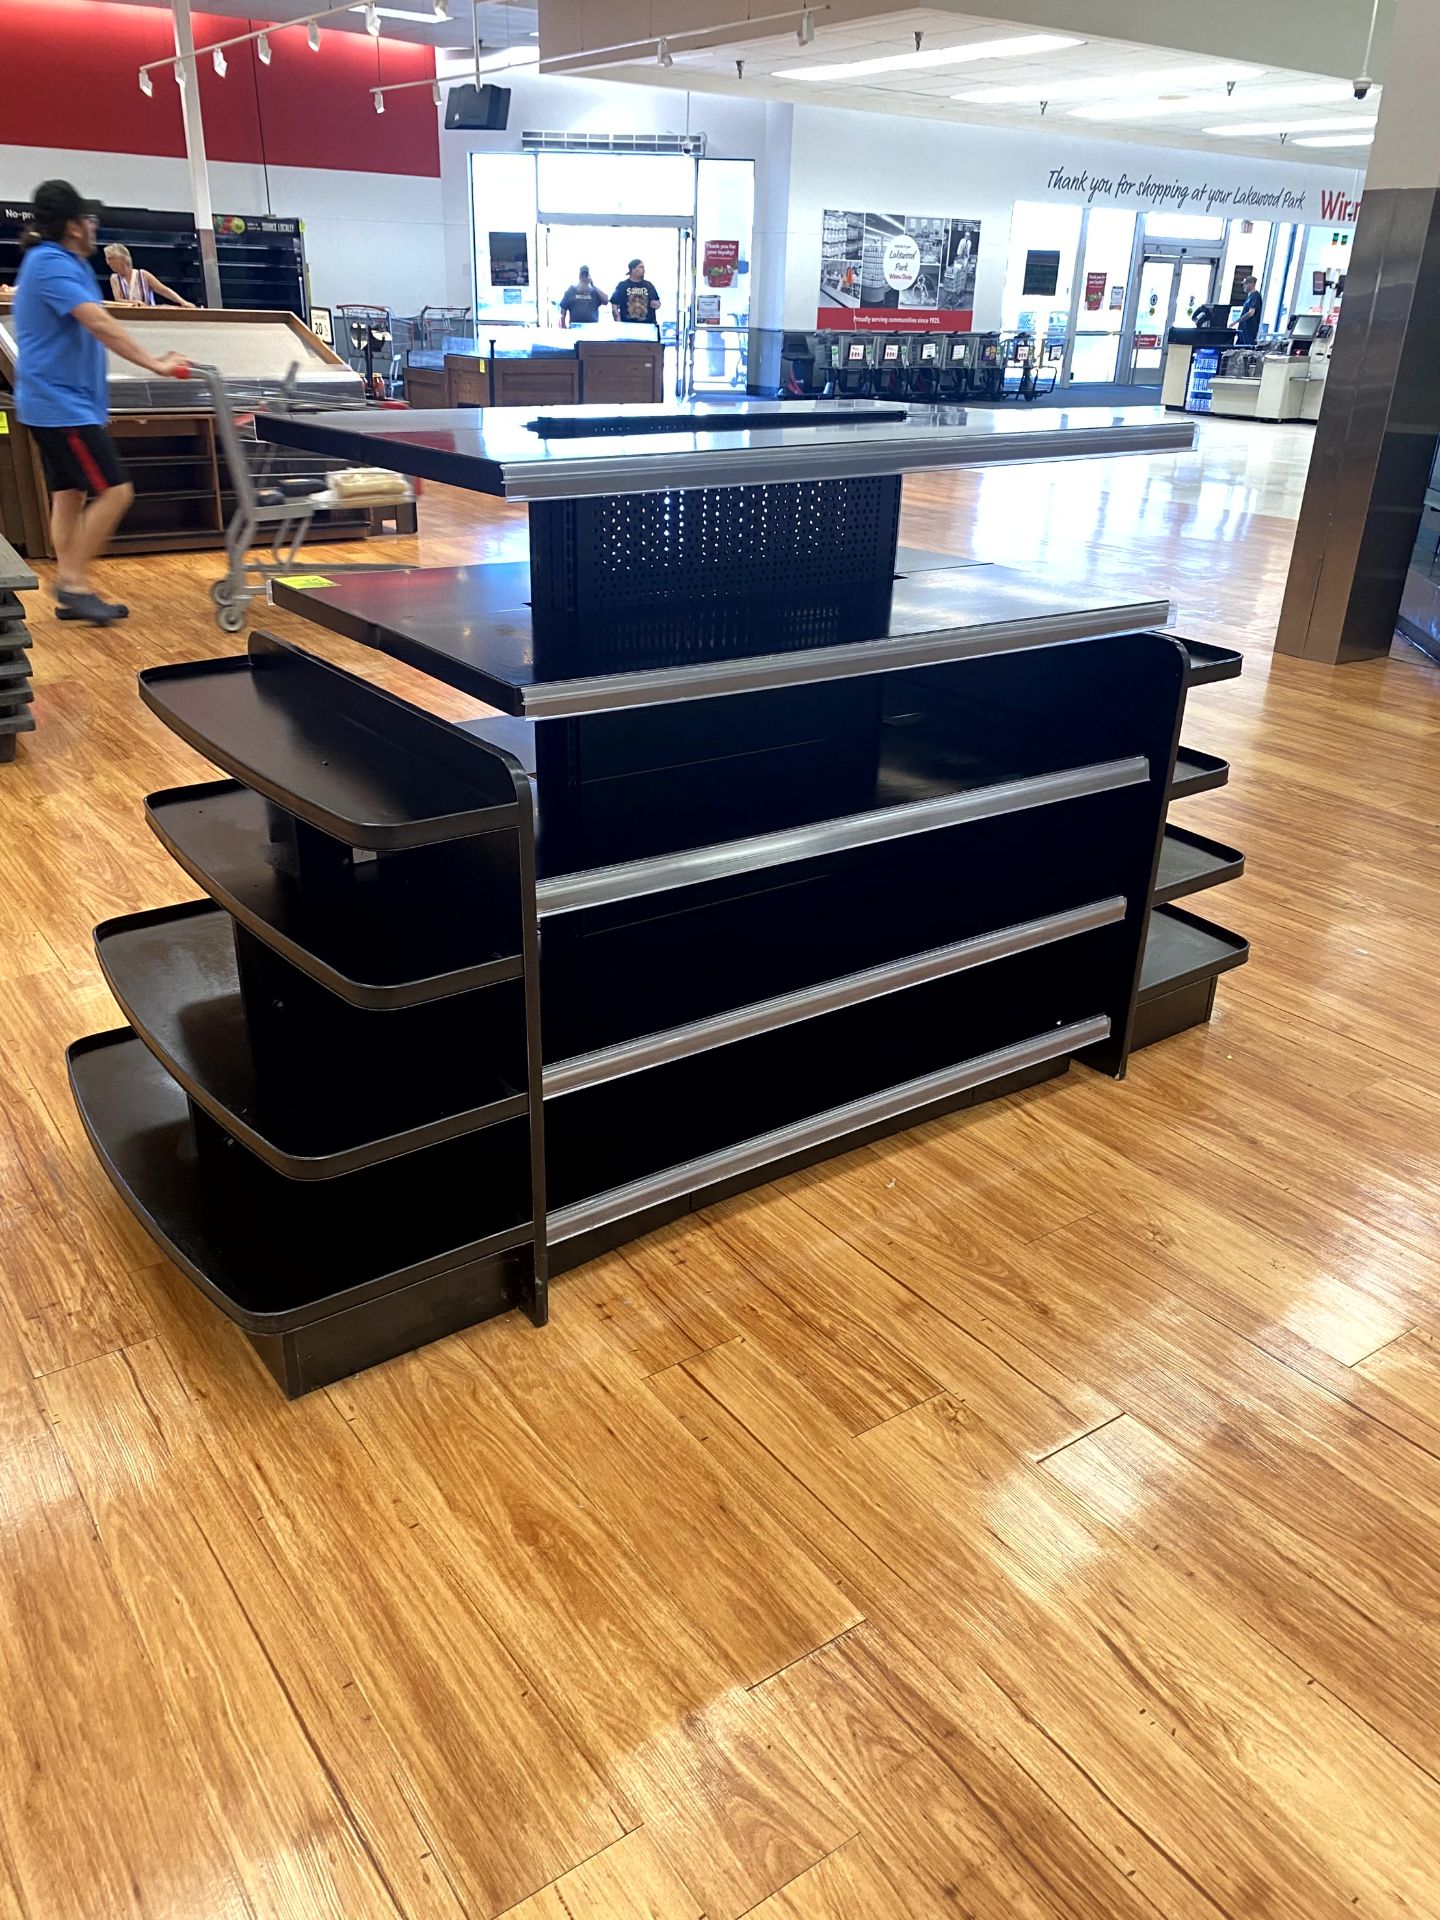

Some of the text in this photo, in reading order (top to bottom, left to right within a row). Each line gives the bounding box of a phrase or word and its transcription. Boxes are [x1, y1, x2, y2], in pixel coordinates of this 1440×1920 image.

[1047, 166, 1088, 192] Thank
[1087, 177, 1113, 203] you
[1114, 173, 1136, 199] for
[1136, 174, 1190, 209] shopping
[1191, 183, 1208, 201] at
[1206, 188, 1233, 213] your
[1232, 186, 1285, 209] Lakewood
[1282, 190, 1306, 210] Park
[889, 250, 918, 260] Lakewood
[895, 262, 909, 272] Park
[871, 317, 888, 325] serving
[888, 316, 917, 324] communities
